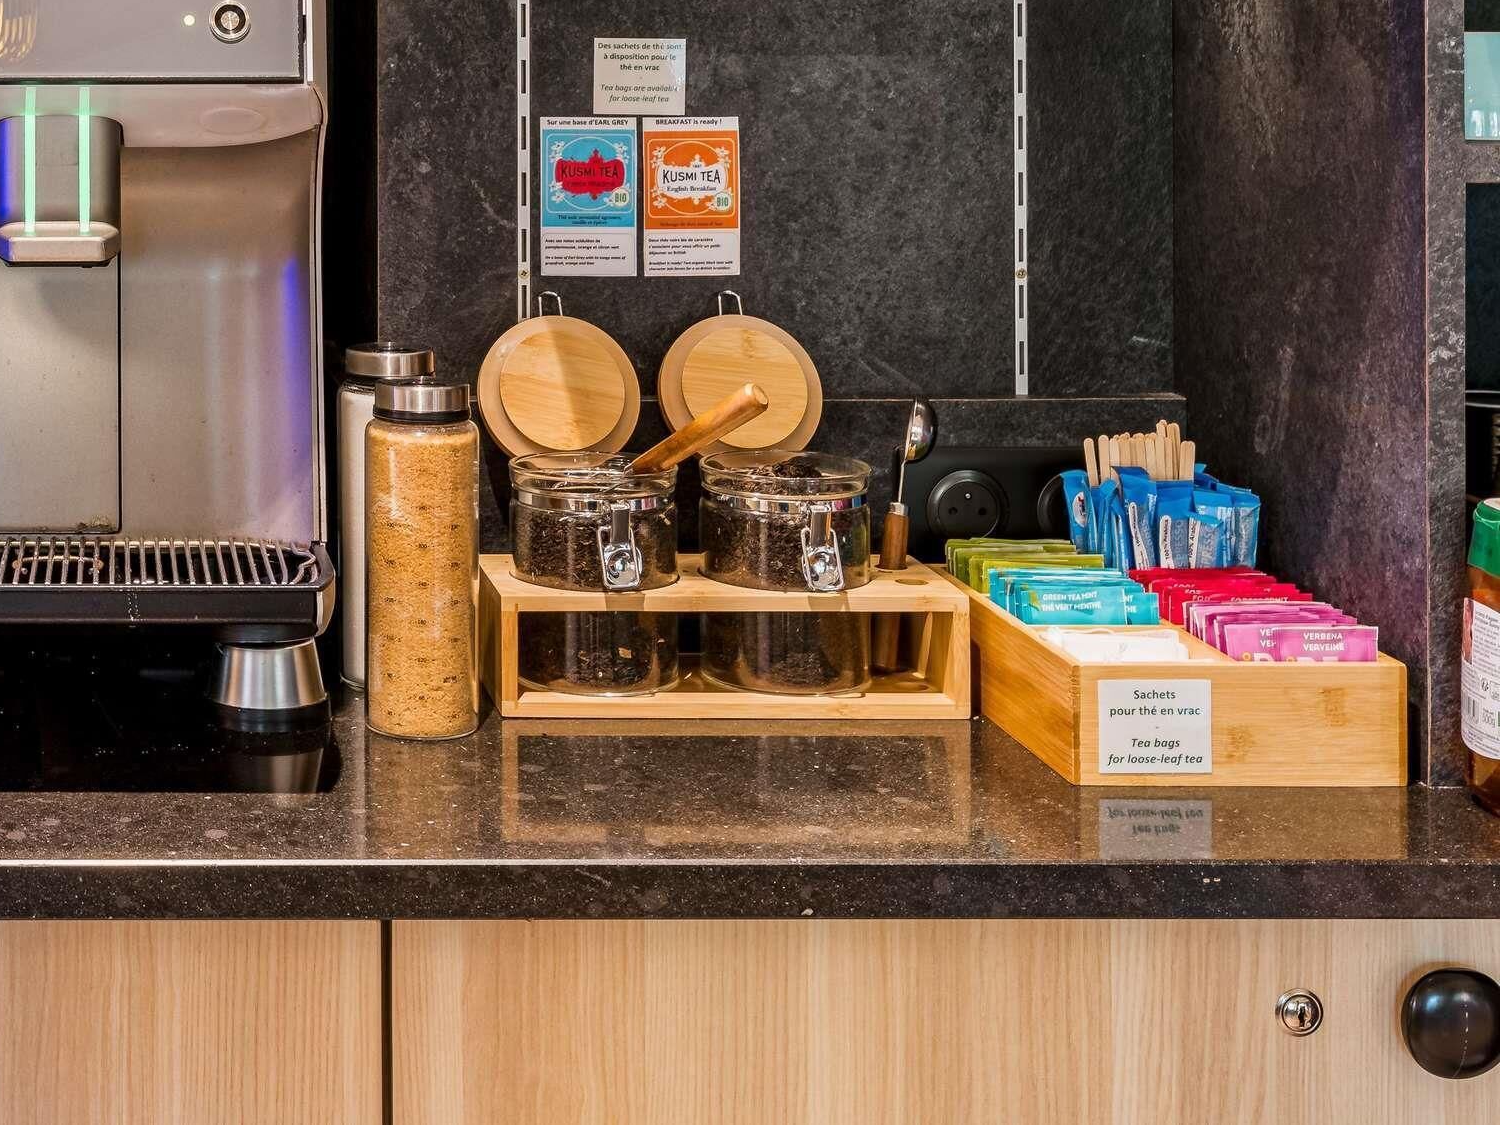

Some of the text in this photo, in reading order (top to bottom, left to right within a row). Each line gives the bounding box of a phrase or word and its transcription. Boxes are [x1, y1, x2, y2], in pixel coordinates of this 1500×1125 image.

[598, 42, 612, 50] Des
[613, 42, 640, 50] sachets
[642, 42, 651, 50] de
[609, 53, 650, 62] disposition
[651, 54, 668, 62] pour
[620, 63, 632, 71] thé
[614, 84, 632, 93] bags
[609, 95, 620, 103] for
[588, 118, 610, 126] d'EARL
[612, 118, 629, 126] GREY
[655, 118, 692, 126] BREAKFAST
[700, 118, 718, 126] ready
[561, 165, 619, 179] KUSMI TEA
[662, 169, 721, 184] KUSMI TEA
[666, 185, 689, 193] English
[614, 193, 627, 203] BIO
[716, 195, 729, 207] BIO
[1042, 593, 1067, 601] GREEN
[1068, 593, 1081, 601] TEA
[1055, 603, 1073, 611] VERT
[1303, 632, 1343, 640] VERBENA
[1303, 642, 1345, 651] VERVEINE
[1133, 689, 1176, 700] Sachets
[1110, 705, 1201, 719] pour thé en vrac
[1131, 738, 1180, 750] Tea bags
[1108, 753, 1203, 768] for loose-leaf tea
